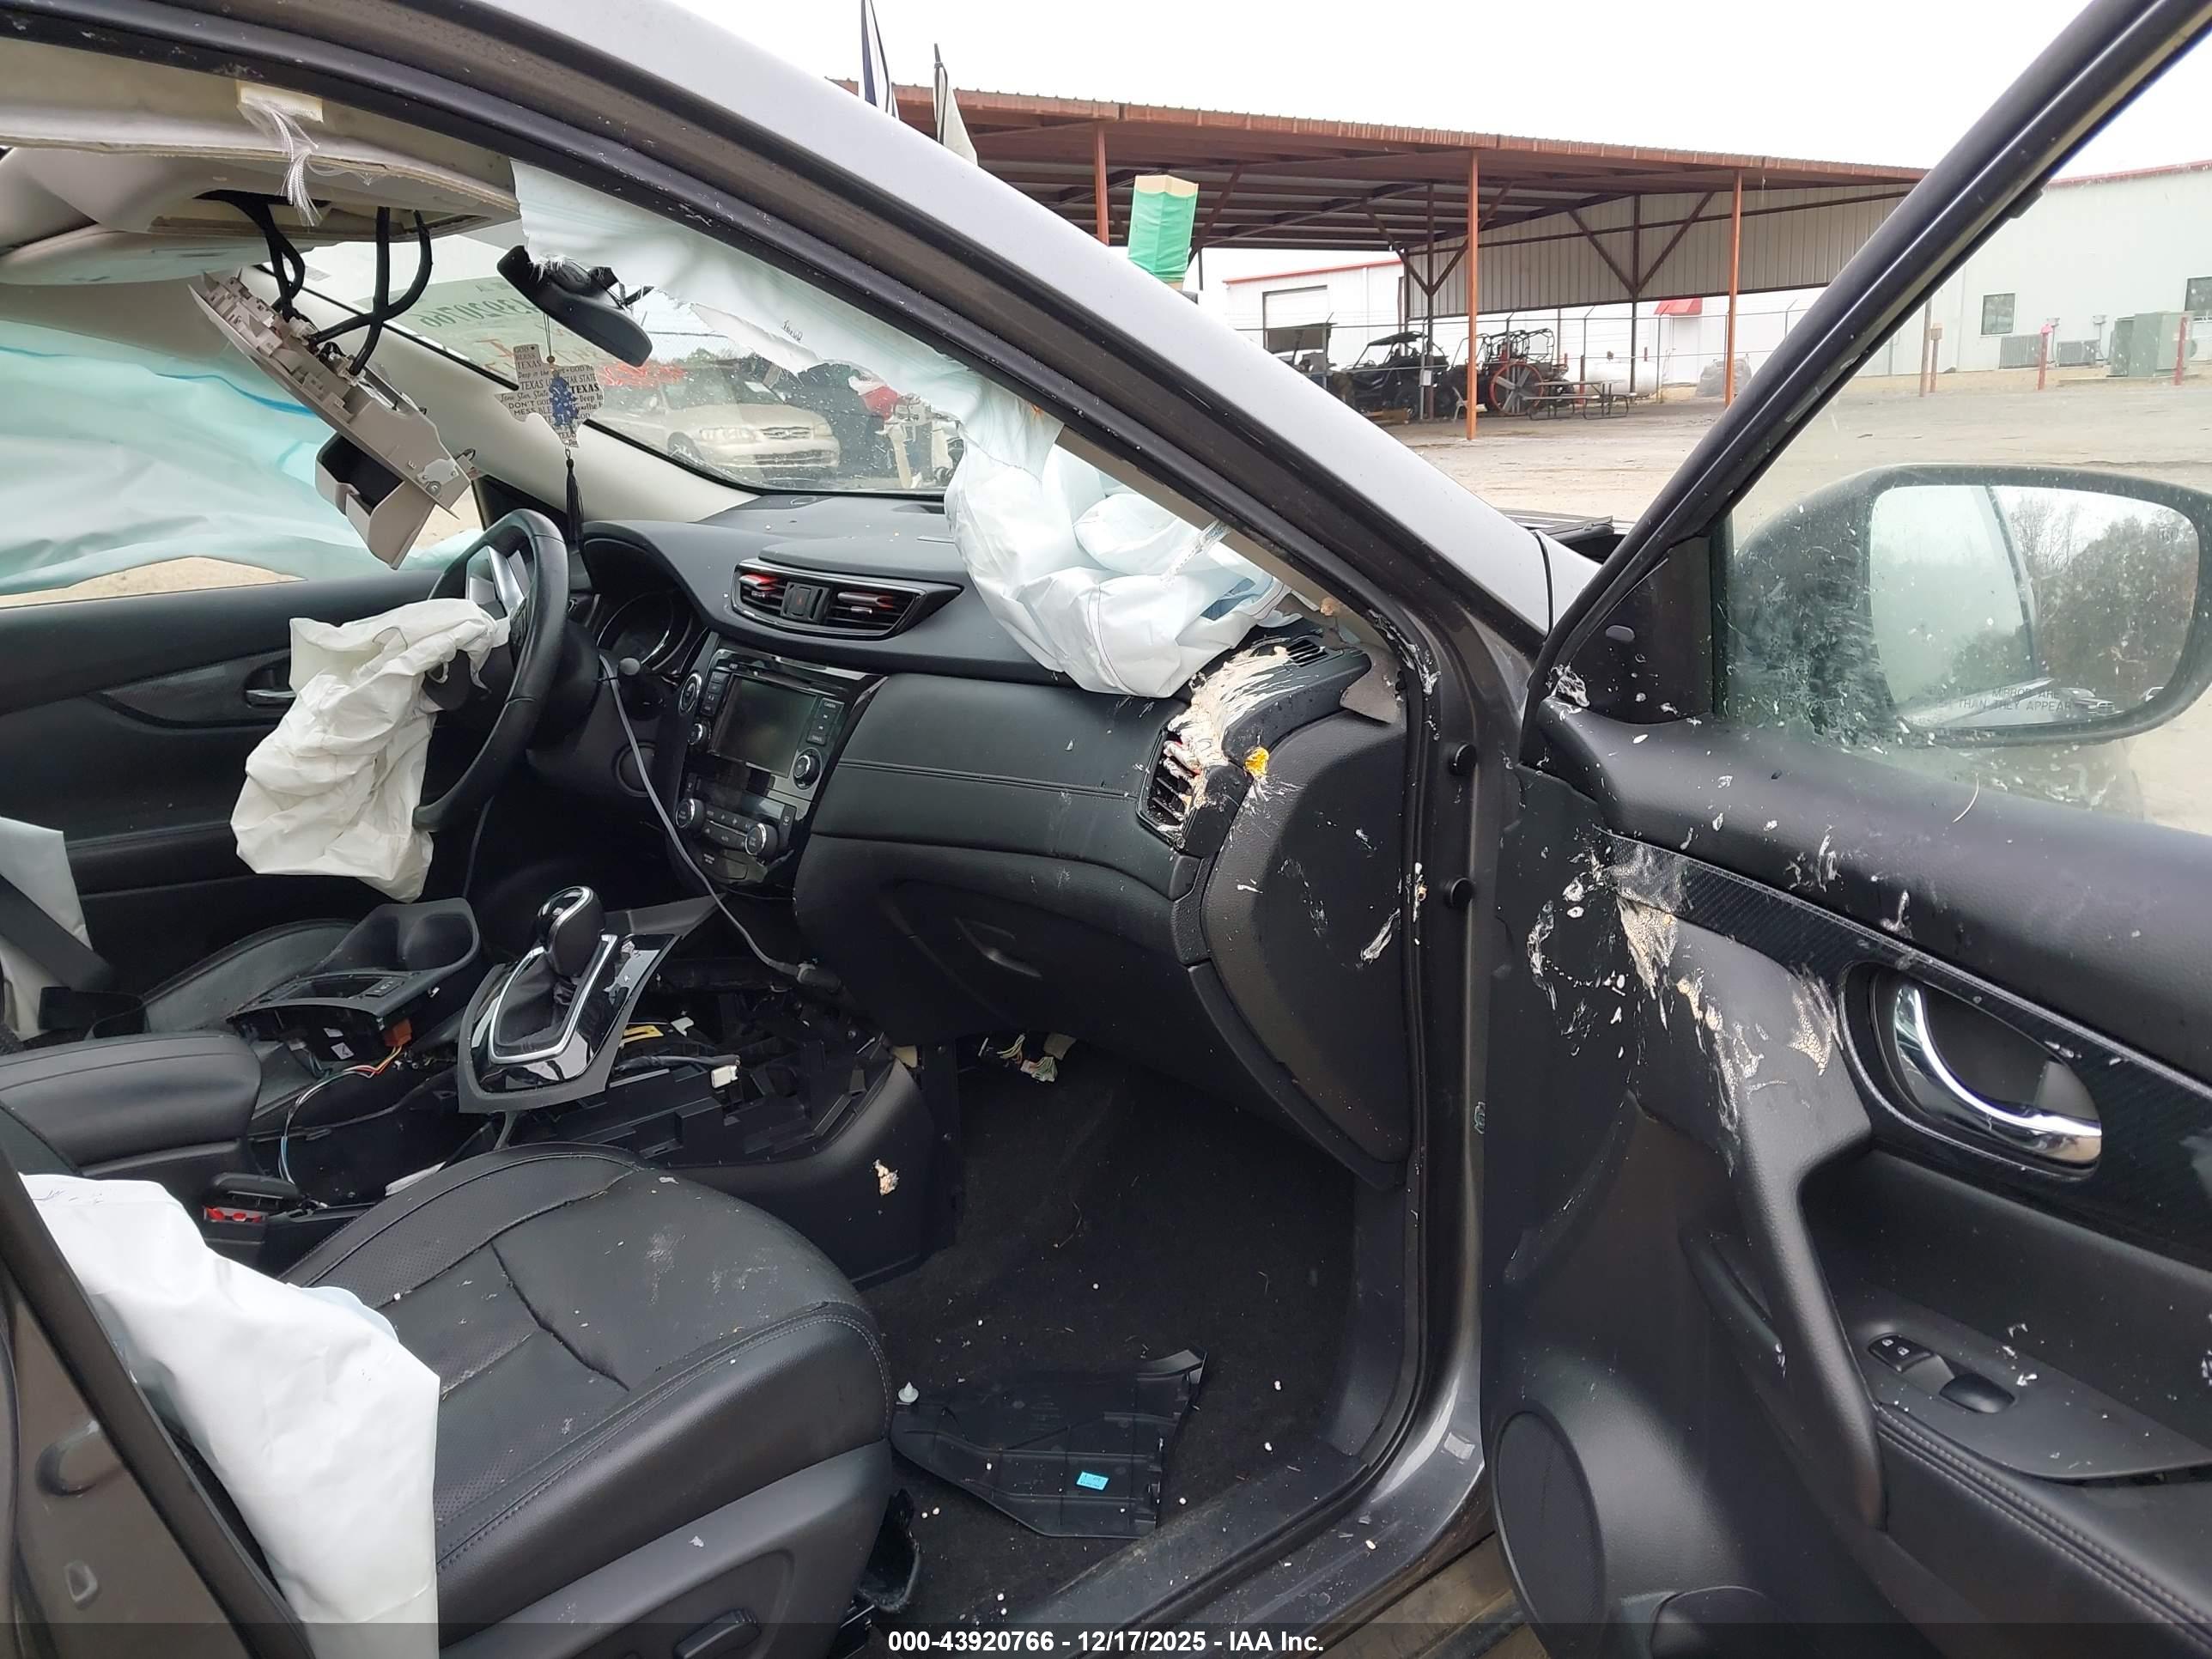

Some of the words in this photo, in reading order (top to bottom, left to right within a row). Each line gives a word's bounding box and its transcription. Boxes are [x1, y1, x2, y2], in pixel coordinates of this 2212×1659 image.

[517, 361, 542, 370] TEXAS
[520, 380, 544, 391] TEXAS
[579, 373, 597, 382] STATE
[570, 384, 600, 394] TEXAS
[517, 391, 532, 401] Star
[508, 400, 534, 410] DON'T
[514, 408, 537, 416] MESS
[2026, 700, 2073, 712] APPEAR
